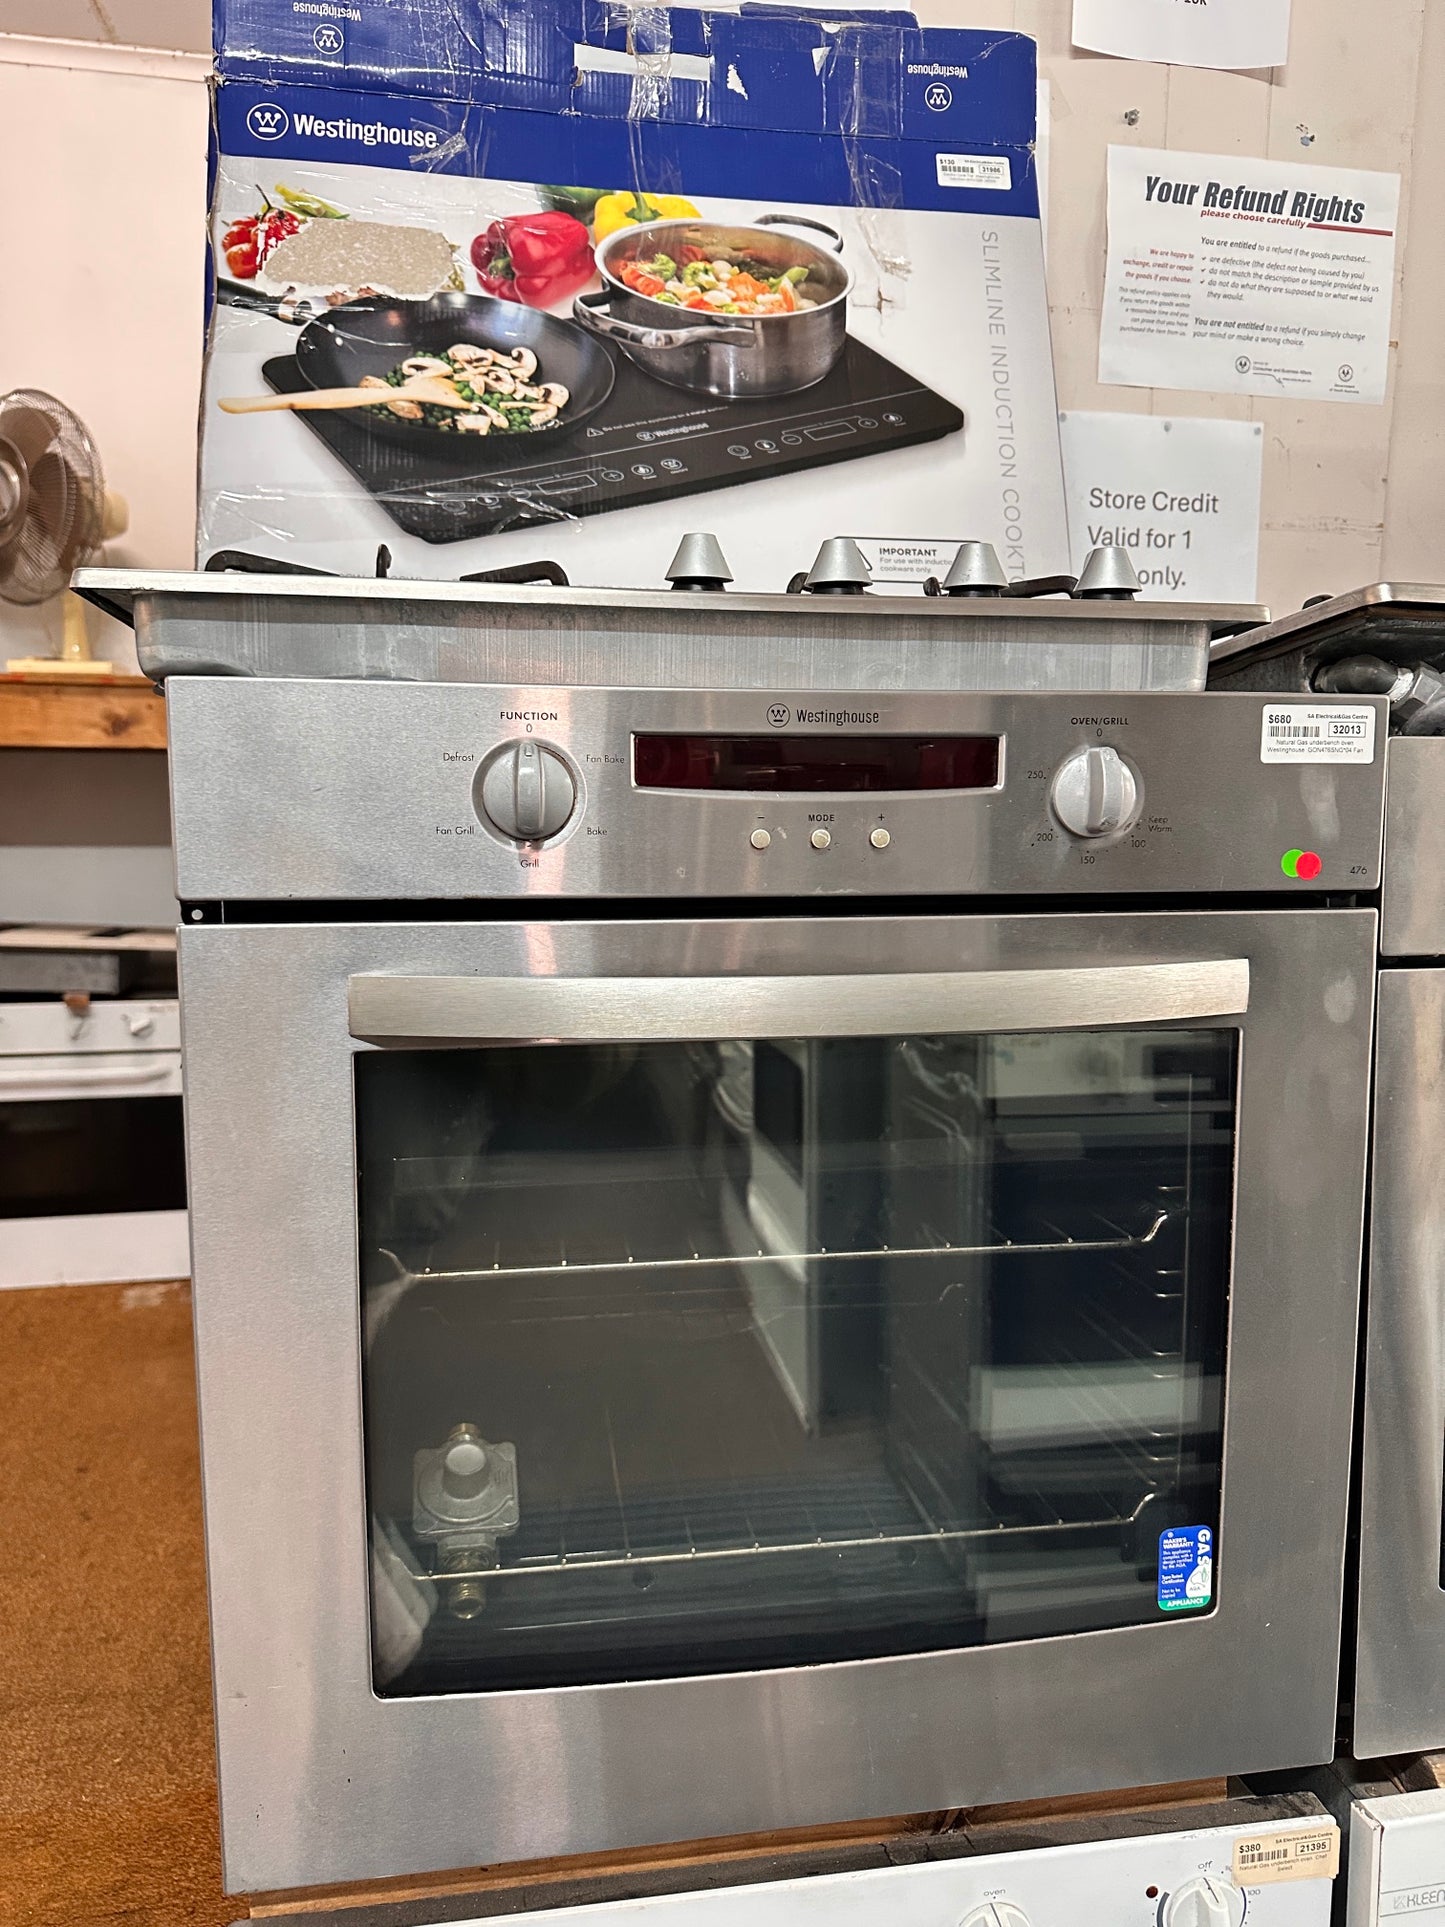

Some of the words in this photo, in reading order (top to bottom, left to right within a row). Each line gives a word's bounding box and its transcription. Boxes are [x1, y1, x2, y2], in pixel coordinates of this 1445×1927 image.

[293, 1, 361, 22] Westinghouse
[907, 63, 969, 79] Westinghouse
[293, 113, 437, 148] Westinghouse
[1145, 175, 1200, 205] Your
[1203, 181, 1289, 215] Refund
[1290, 190, 1366, 224] Rights
[1200, 209, 1231, 219] please
[1232, 212, 1265, 223] choose
[1266, 215, 1306, 229] carefully
[1201, 236, 1215, 246] You
[1216, 239, 1228, 247] are
[1229, 240, 1257, 250] entitled
[1271, 245, 1293, 255] refund
[1294, 248, 1299, 256] if
[1310, 251, 1331, 259] goods
[1169, 250, 1187, 259] happy
[1221, 257, 1251, 267] defective
[1265, 261, 1286, 271] defect
[1298, 264, 1317, 276] being
[1317, 268, 1341, 277] caused
[1341, 270, 1349, 279] by
[1135, 272, 1153, 280] goods
[1208, 267, 1218, 275] do
[1231, 270, 1251, 278] match
[1252, 272, 1263, 280] the
[1264, 274, 1300, 284] description
[1309, 279, 1332, 288] sample
[1333, 281, 1361, 290] provided
[1362, 283, 1370, 292] by
[981, 230, 1006, 335] SLIMLINE
[1206, 291, 1221, 299] they
[1218, 280, 1229, 288] not
[1257, 284, 1271, 293] they
[1284, 287, 1316, 296] supposed
[1359, 295, 1373, 303] said
[1194, 317, 1208, 326] You
[1209, 319, 1222, 327] are
[1223, 320, 1236, 328] not
[1236, 321, 1265, 331] entitled
[1279, 325, 1301, 335] refund
[1301, 327, 1307, 335] if
[1307, 329, 1319, 337] you
[1320, 329, 1341, 339] simply
[1342, 331, 1366, 342] change
[1192, 330, 1208, 338] your
[1208, 331, 1226, 339] mind
[1235, 333, 1254, 341] make
[1260, 337, 1281, 346] wrong
[990, 346, 1018, 478] INDUCTION
[654, 422, 709, 437] Westinghouse
[1089, 487, 1146, 510] Store
[1152, 491, 1219, 513] Credit
[1001, 488, 1026, 582] COOKT
[1087, 525, 1140, 548] Valid
[1147, 528, 1176, 549] for
[1182, 530, 1192, 549] 1
[879, 547, 937, 556] IMPORTANT
[1138, 566, 1186, 590] only.
[500, 711, 558, 721] FUNCTION
[796, 708, 880, 728] Westinghouse
[1268, 714, 1292, 724] $680
[1070, 717, 1129, 726] OVEN/GRILL
[1332, 725, 1361, 734] 32013
[443, 752, 475, 762] Defrost
[586, 754, 602, 764] Fan
[604, 754, 625, 764] Bake
[1027, 770, 1044, 779] 250
[808, 813, 836, 822] MODE
[1148, 816, 1168, 825] Keep
[436, 826, 453, 835] Fan
[455, 826, 475, 835] Grill
[586, 827, 608, 836] Bake
[1148, 824, 1173, 832] Warm
[1036, 833, 1053, 842] 200
[1131, 839, 1146, 848] 100
[520, 859, 540, 868] Grill
[1080, 856, 1095, 864] 150
[1350, 866, 1367, 875] 476
[1197, 1529, 1211, 1566] GAS
[1167, 1597, 1204, 1607] APPLIANCE
[1239, 1843, 1261, 1853] $380
[1300, 1842, 1327, 1853] 21395
[1198, 1860, 1213, 1869] off
[1239, 1863, 1258, 1871] Natural
[1270, 1858, 1299, 1867] underbench
[983, 1888, 1006, 1896] oven
